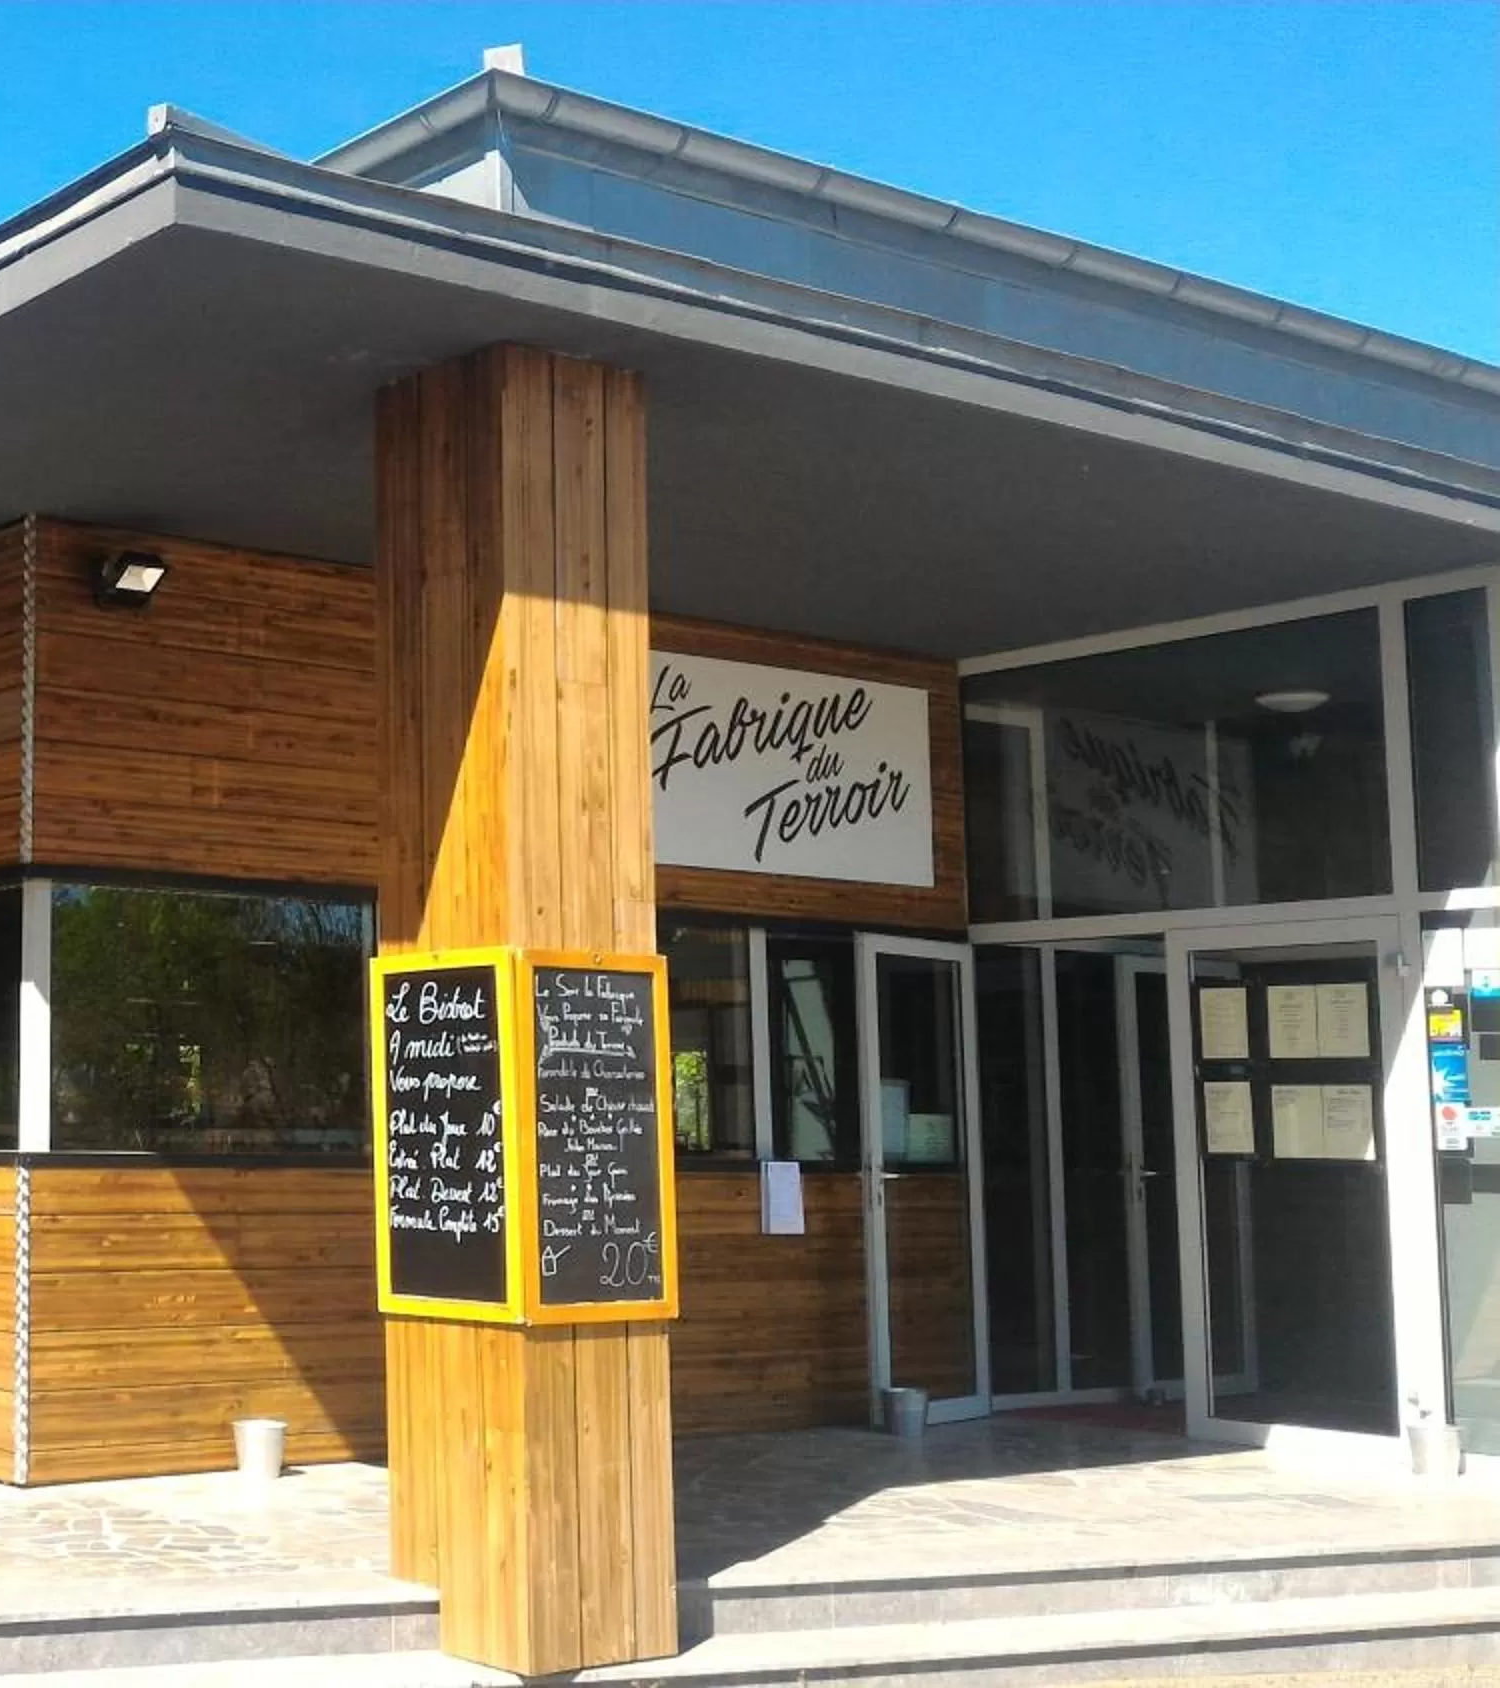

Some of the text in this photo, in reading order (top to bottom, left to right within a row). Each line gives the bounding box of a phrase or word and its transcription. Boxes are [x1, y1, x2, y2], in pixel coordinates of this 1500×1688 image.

[650, 664, 691, 714] La
[650, 687, 873, 791] Fabrique
[806, 744, 844, 783] du
[744, 761, 911, 864] Terroir
[386, 981, 486, 1024] Le Bistrot
[404, 1031, 455, 1059] midi
[389, 1065, 421, 1092] Vous
[390, 1108, 417, 1136] Plat
[419, 1112, 437, 1135] du
[429, 1142, 460, 1171] Plat
